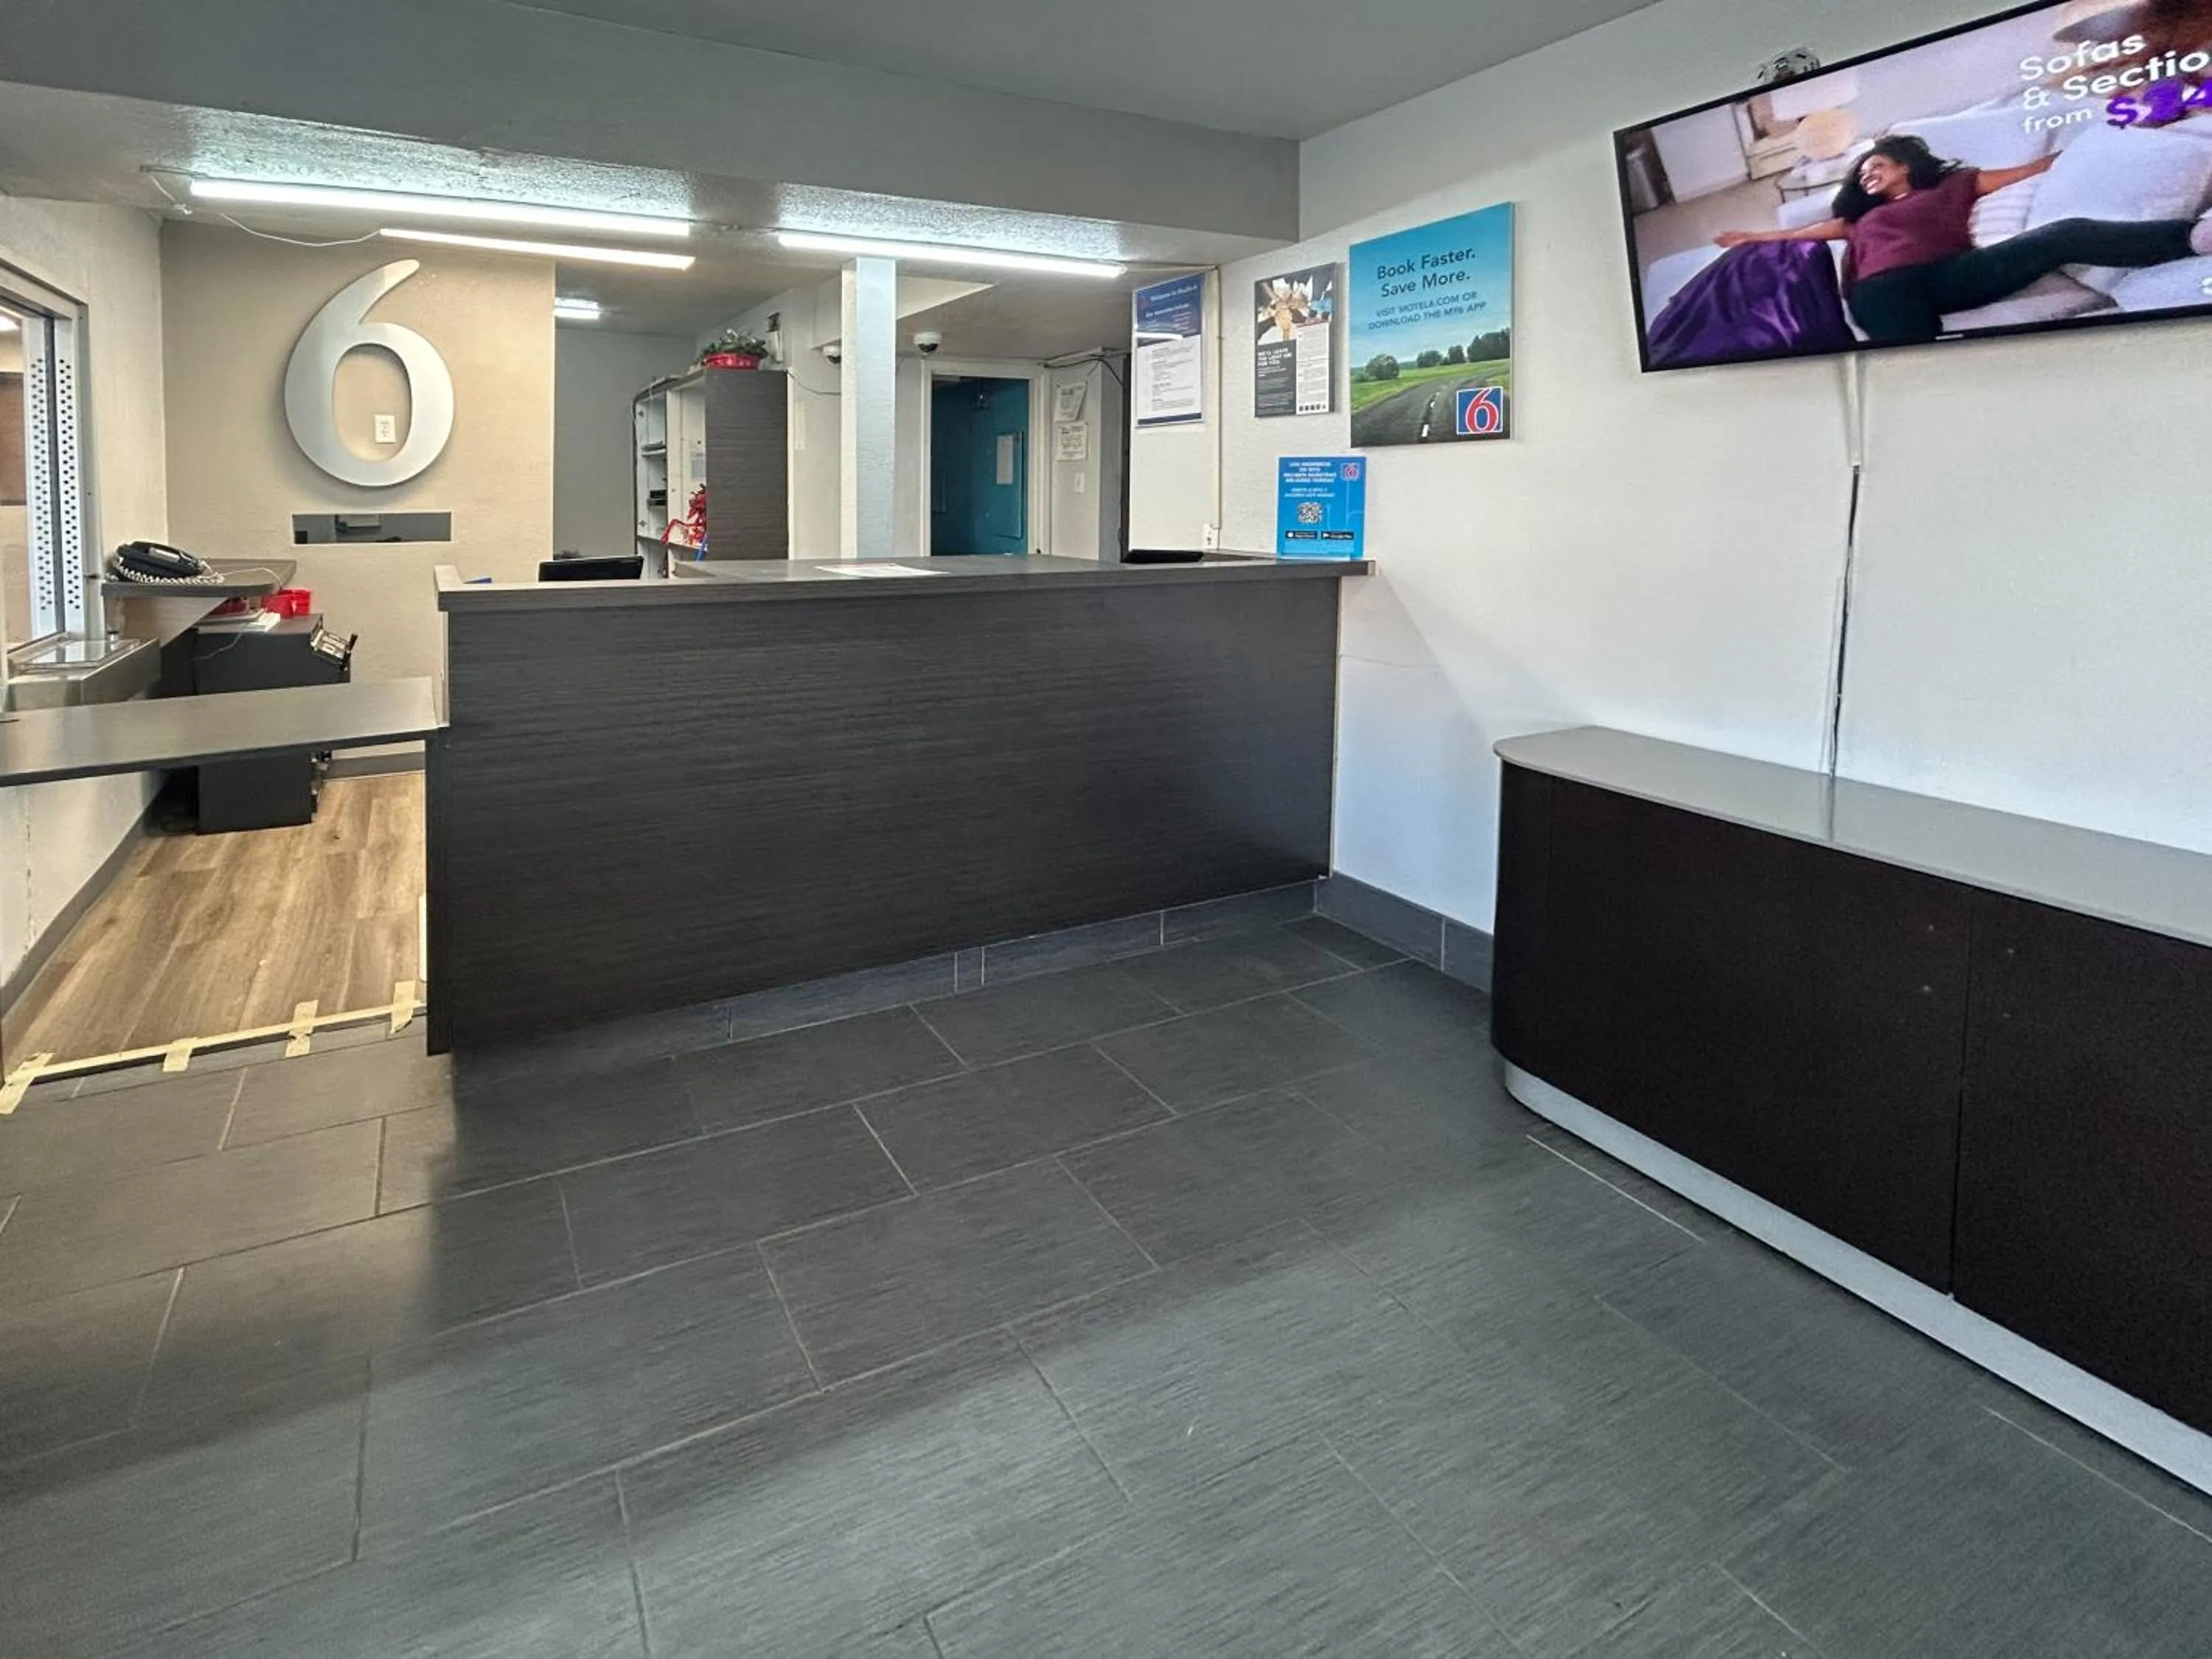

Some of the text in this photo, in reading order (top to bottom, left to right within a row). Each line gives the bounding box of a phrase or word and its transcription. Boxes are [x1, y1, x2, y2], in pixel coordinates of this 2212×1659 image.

[2020, 35, 2147, 80] Sofas
[2023, 86, 2051, 110] &
[2023, 108, 2092, 133] from
[1377, 248, 1475, 279] Book Faster.
[1381, 271, 1471, 297] Save More.
[1368, 313, 1421, 330] DOWNLOAD
[1424, 309, 1441, 319] THE
[1467, 301, 1487, 313] APP
[1376, 306, 1396, 317] VISIT
[1462, 291, 1477, 302] OR
[284, 259, 454, 487] 6
[1466, 388, 1499, 434] 6
